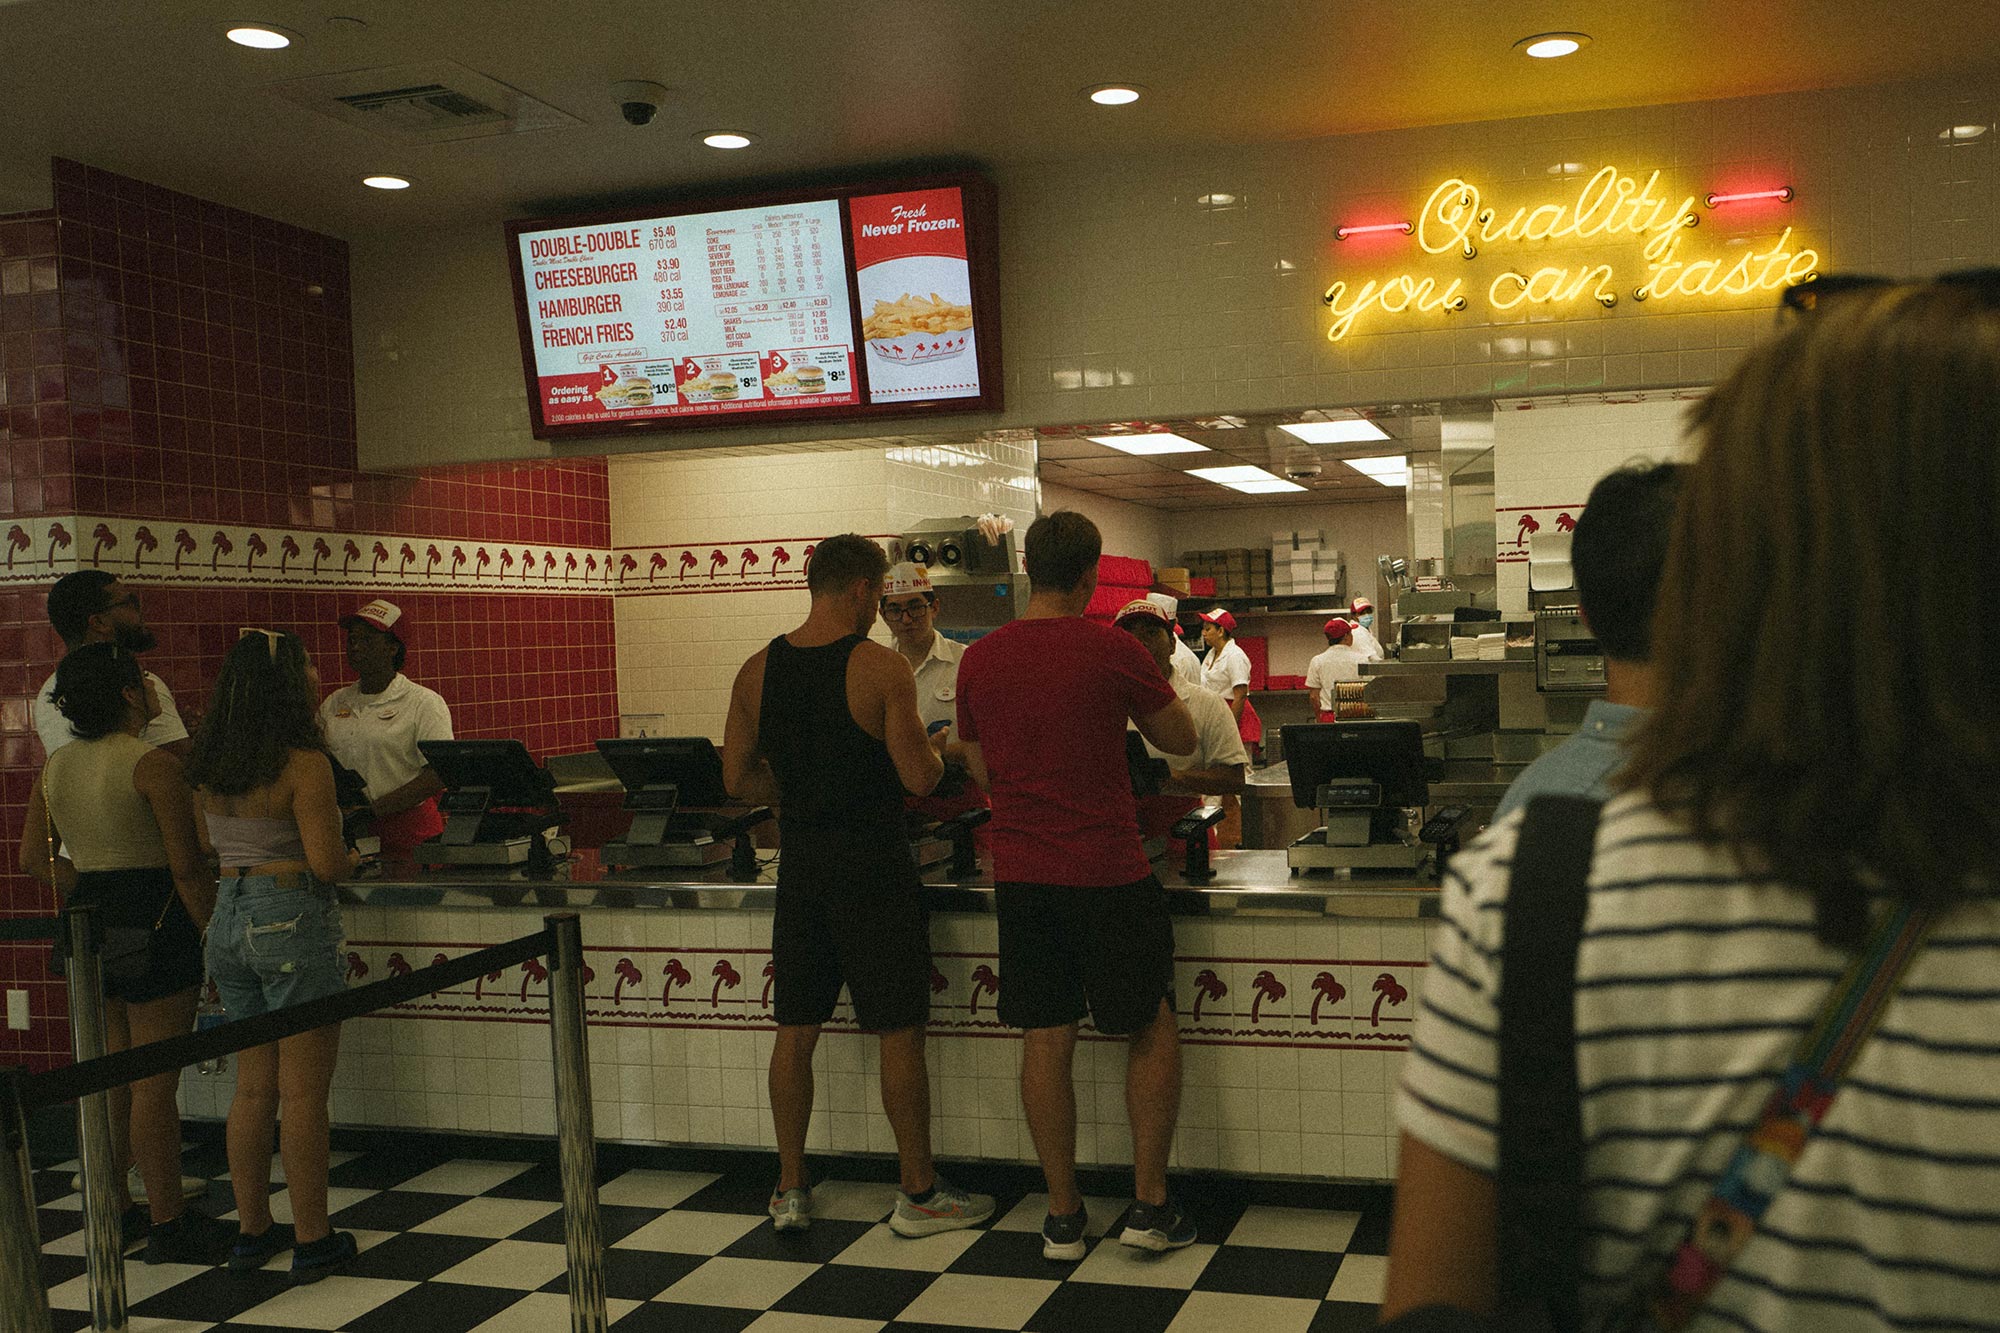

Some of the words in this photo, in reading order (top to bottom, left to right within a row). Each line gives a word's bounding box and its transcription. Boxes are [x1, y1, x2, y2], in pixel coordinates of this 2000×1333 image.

[891, 203, 927, 222] Fresh
[1418, 165, 1695, 260] Quality
[653, 225, 676, 238] $5.40
[862, 224, 904, 238] Never
[908, 218, 960, 233] Frozen.
[530, 229, 641, 259] DOUBLE-DOUBLE
[649, 239, 664, 251] 670
[666, 238, 678, 249] cal
[718, 243, 731, 251] COKE
[657, 258, 680, 270] $3.90
[709, 260, 716, 268] DR
[717, 259, 735, 267] PEPPER
[535, 262, 638, 290] CHEESEBURGER
[653, 271, 668, 283] 480
[670, 270, 681, 282] cal
[711, 275, 722, 283] ICED
[712, 283, 723, 291] PINK
[724, 281, 749, 290] LEMONADE
[1325, 274, 1463, 342] you
[1489, 265, 1613, 310] can
[1636, 227, 1819, 299] taste
[661, 288, 683, 300] $3.55
[713, 290, 738, 299] LEMONADE
[538, 294, 622, 319] HAMBURGER
[656, 301, 671, 313] 390
[673, 300, 685, 312] cal
[664, 317, 687, 329] $2.40
[723, 317, 742, 325] SHAKES
[542, 326, 594, 348] FRENCH
[596, 322, 634, 344] FRIES
[660, 331, 675, 343] 370
[677, 330, 688, 341] cal
[726, 340, 744, 349] COFFEE
[773, 356, 782, 368] 3
[686, 363, 695, 375] 2
[551, 384, 589, 396] Ordering
[549, 397, 559, 405] as
[561, 395, 581, 406] easy
[583, 394, 593, 402] as
[565, 413, 581, 421] calories
[586, 413, 594, 421] day
[600, 411, 610, 419] used
[618, 410, 634, 418] general
[635, 408, 653, 416] nutrition
[721, 402, 743, 410] Additional
[744, 400, 766, 408] nutritional
[767, 399, 793, 407] information
[799, 397, 819, 405] available
[820, 396, 832, 404] upon
